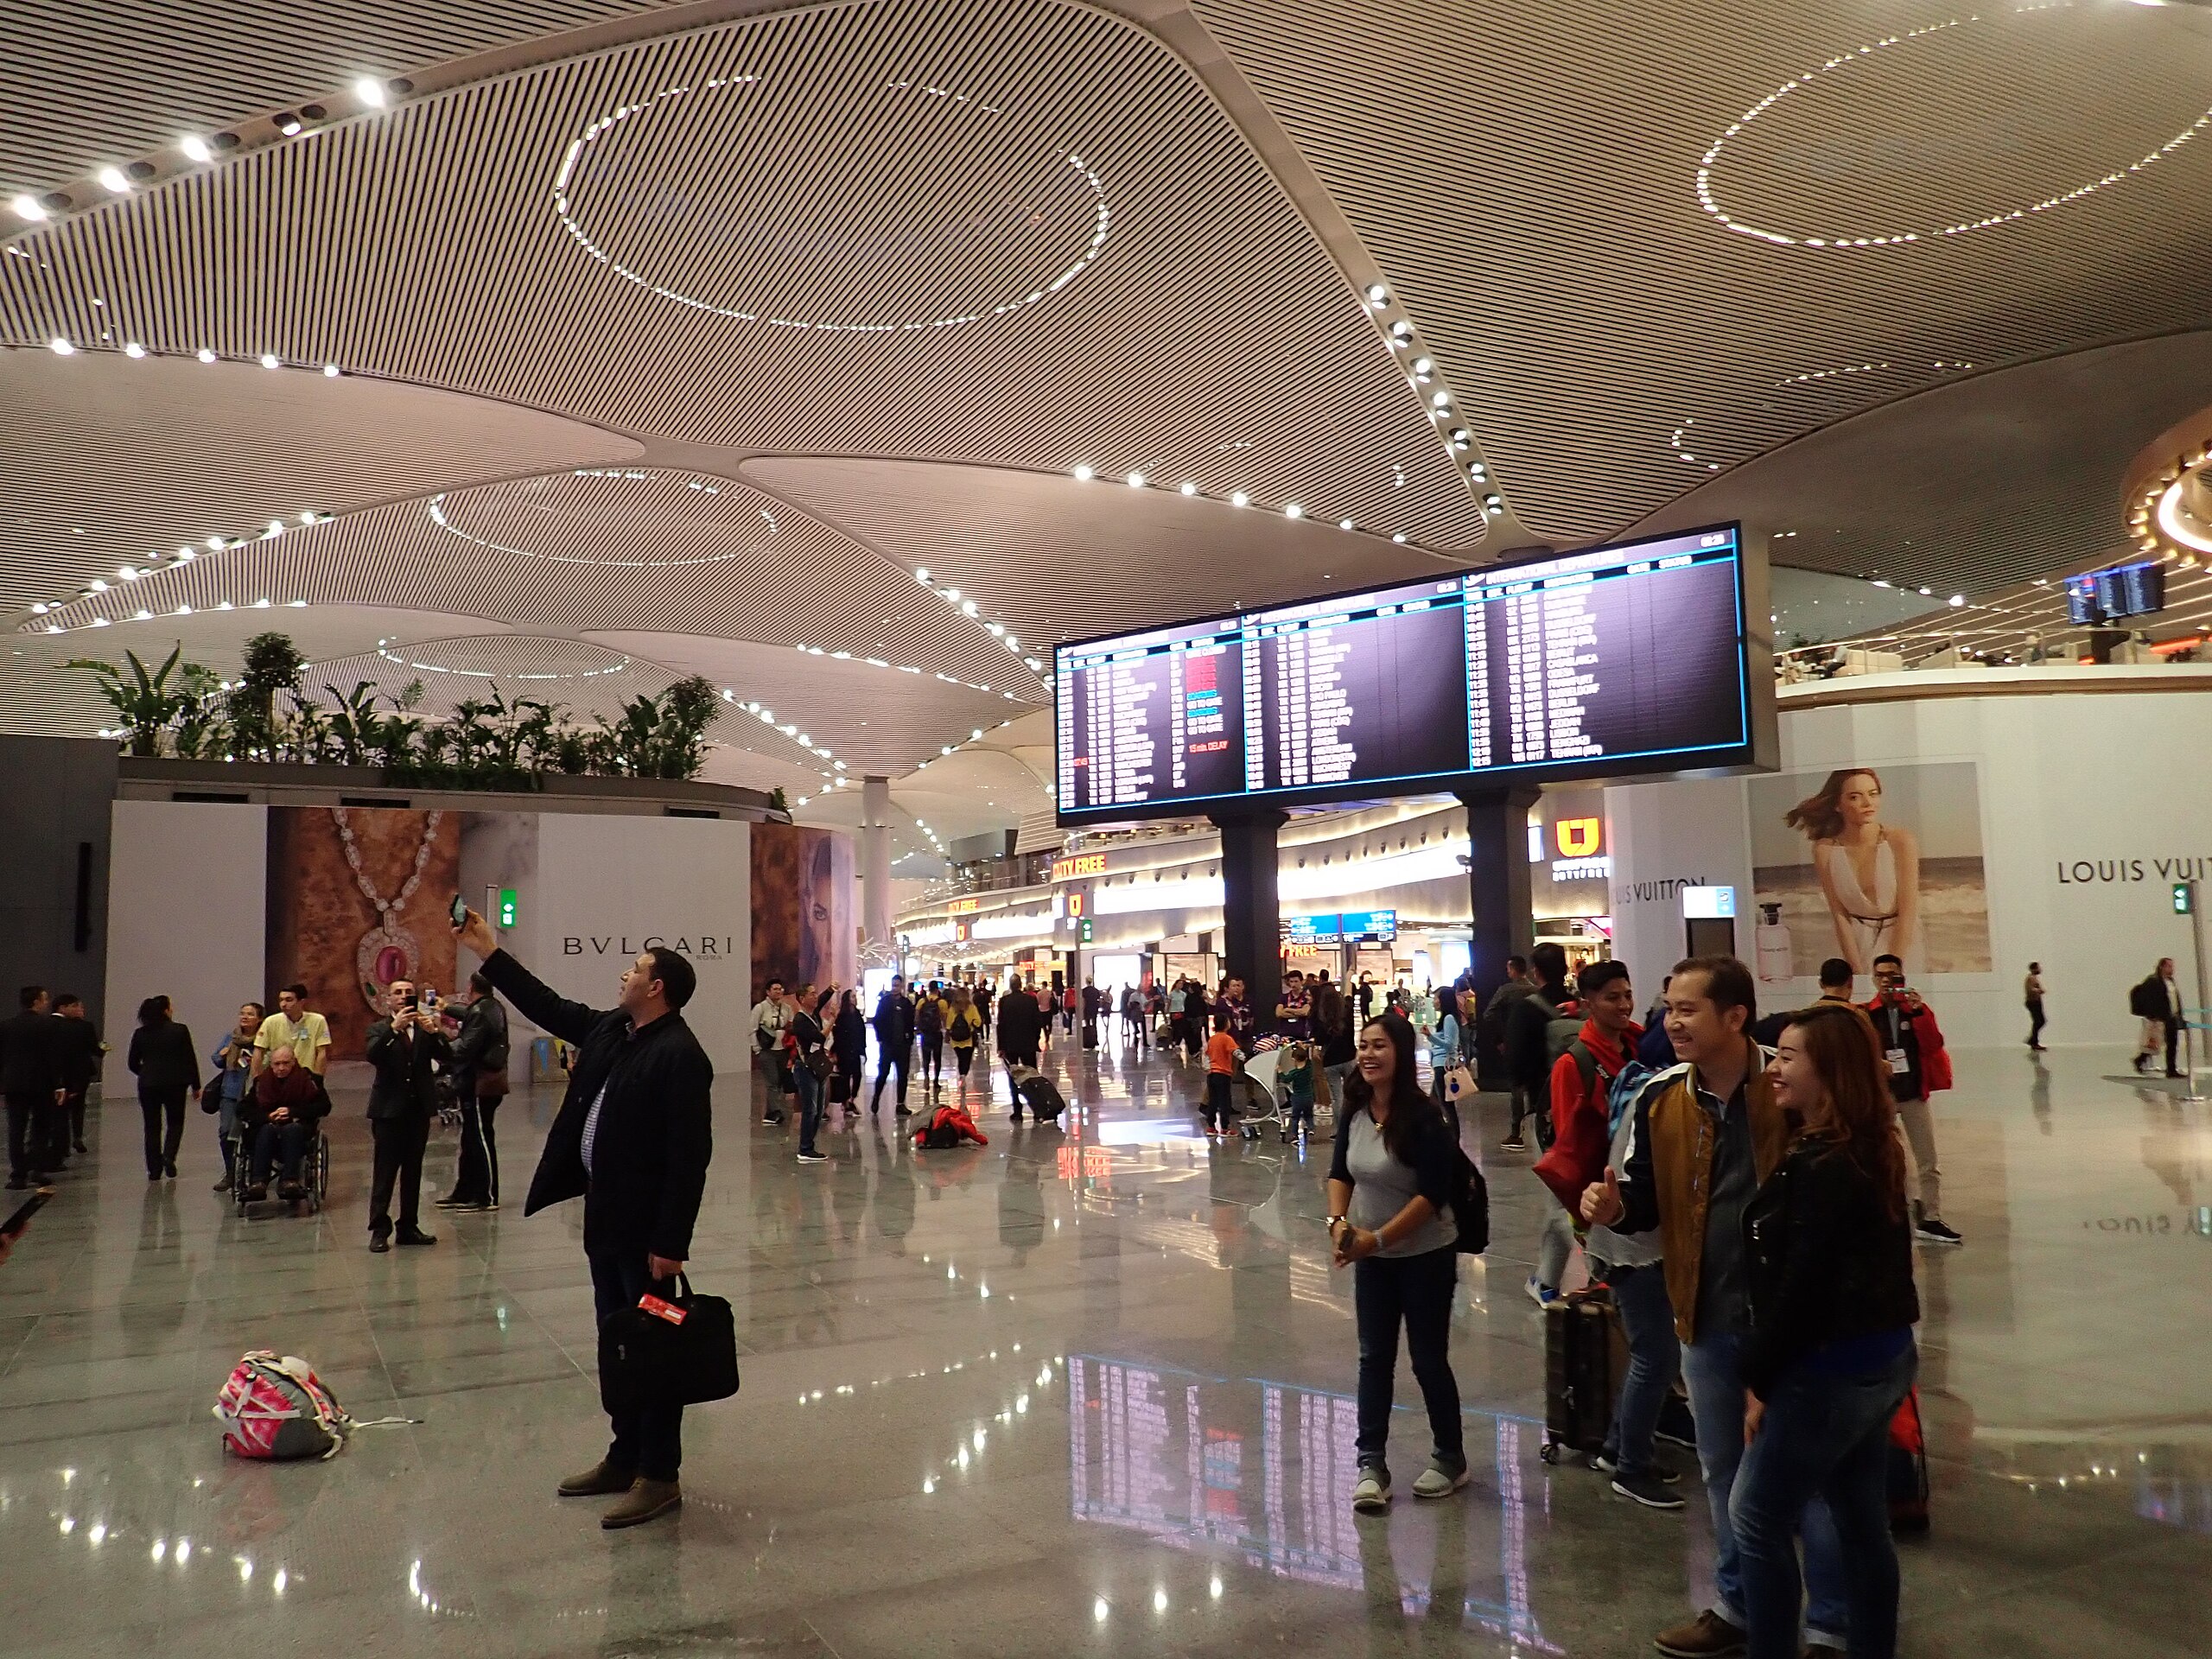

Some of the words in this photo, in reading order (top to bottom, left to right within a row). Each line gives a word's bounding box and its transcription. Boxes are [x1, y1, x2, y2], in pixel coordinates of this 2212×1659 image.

[1208, 741, 1229, 751] DELAY
[1075, 855, 1107, 874] FREE
[2057, 860, 2145, 884] LOUIS
[2153, 857, 2212, 880] VUI
